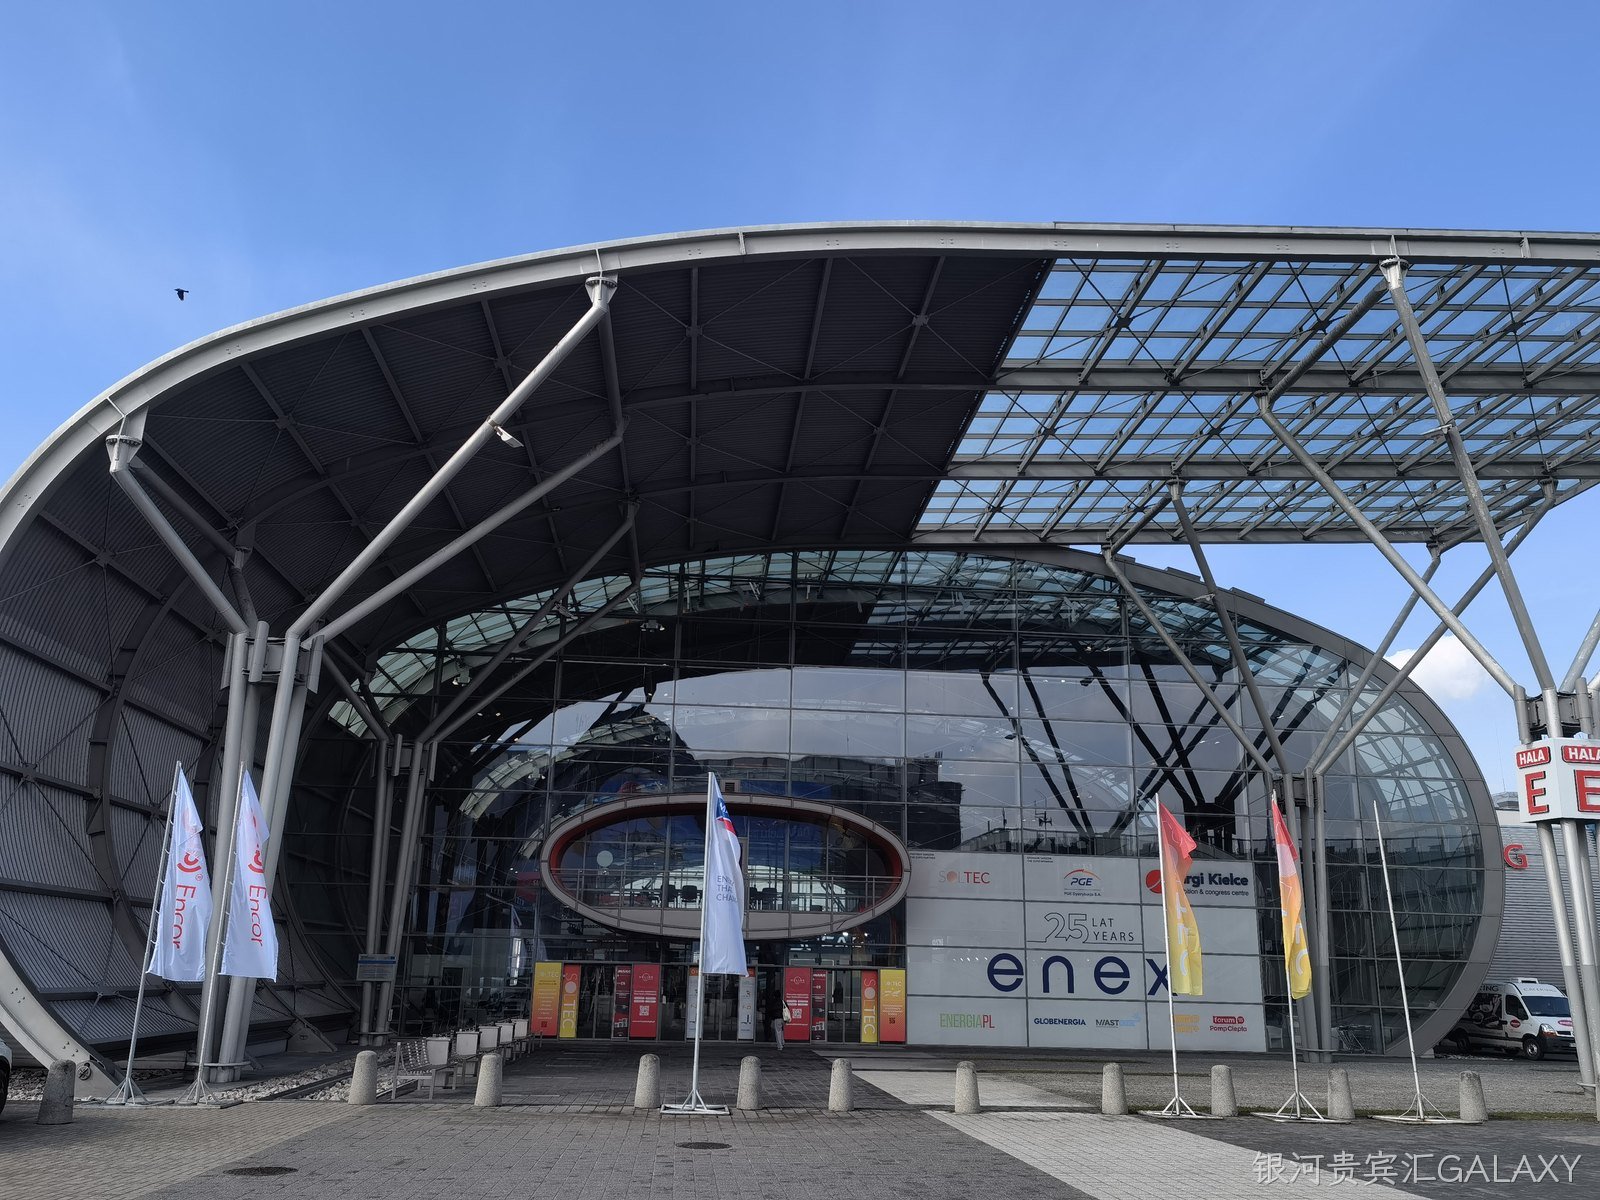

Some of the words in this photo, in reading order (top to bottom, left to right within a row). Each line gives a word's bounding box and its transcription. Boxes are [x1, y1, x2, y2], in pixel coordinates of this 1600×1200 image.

[1519, 749, 1545, 765] HALA
[1525, 771, 1550, 815] E
[1574, 769, 1600, 813] E
[1504, 844, 1528, 869] G
[939, 870, 991, 884] SOLTEC
[1070, 877, 1093, 886] PGE
[1184, 872, 1205, 888] rgi
[1208, 873, 1249, 886] Kielce
[1205, 889, 1231, 897] congress
[249, 885, 268, 947] Encor
[1091, 917, 1114, 928] LAT
[1044, 912, 1090, 943] 25
[1093, 931, 1135, 942] YEARS
[987, 953, 1178, 996] enex
[563, 973, 578, 1029] SOLTEC
[863, 978, 877, 1034] SOLTEC
[1033, 1017, 1086, 1026] GLOBENERGIA
